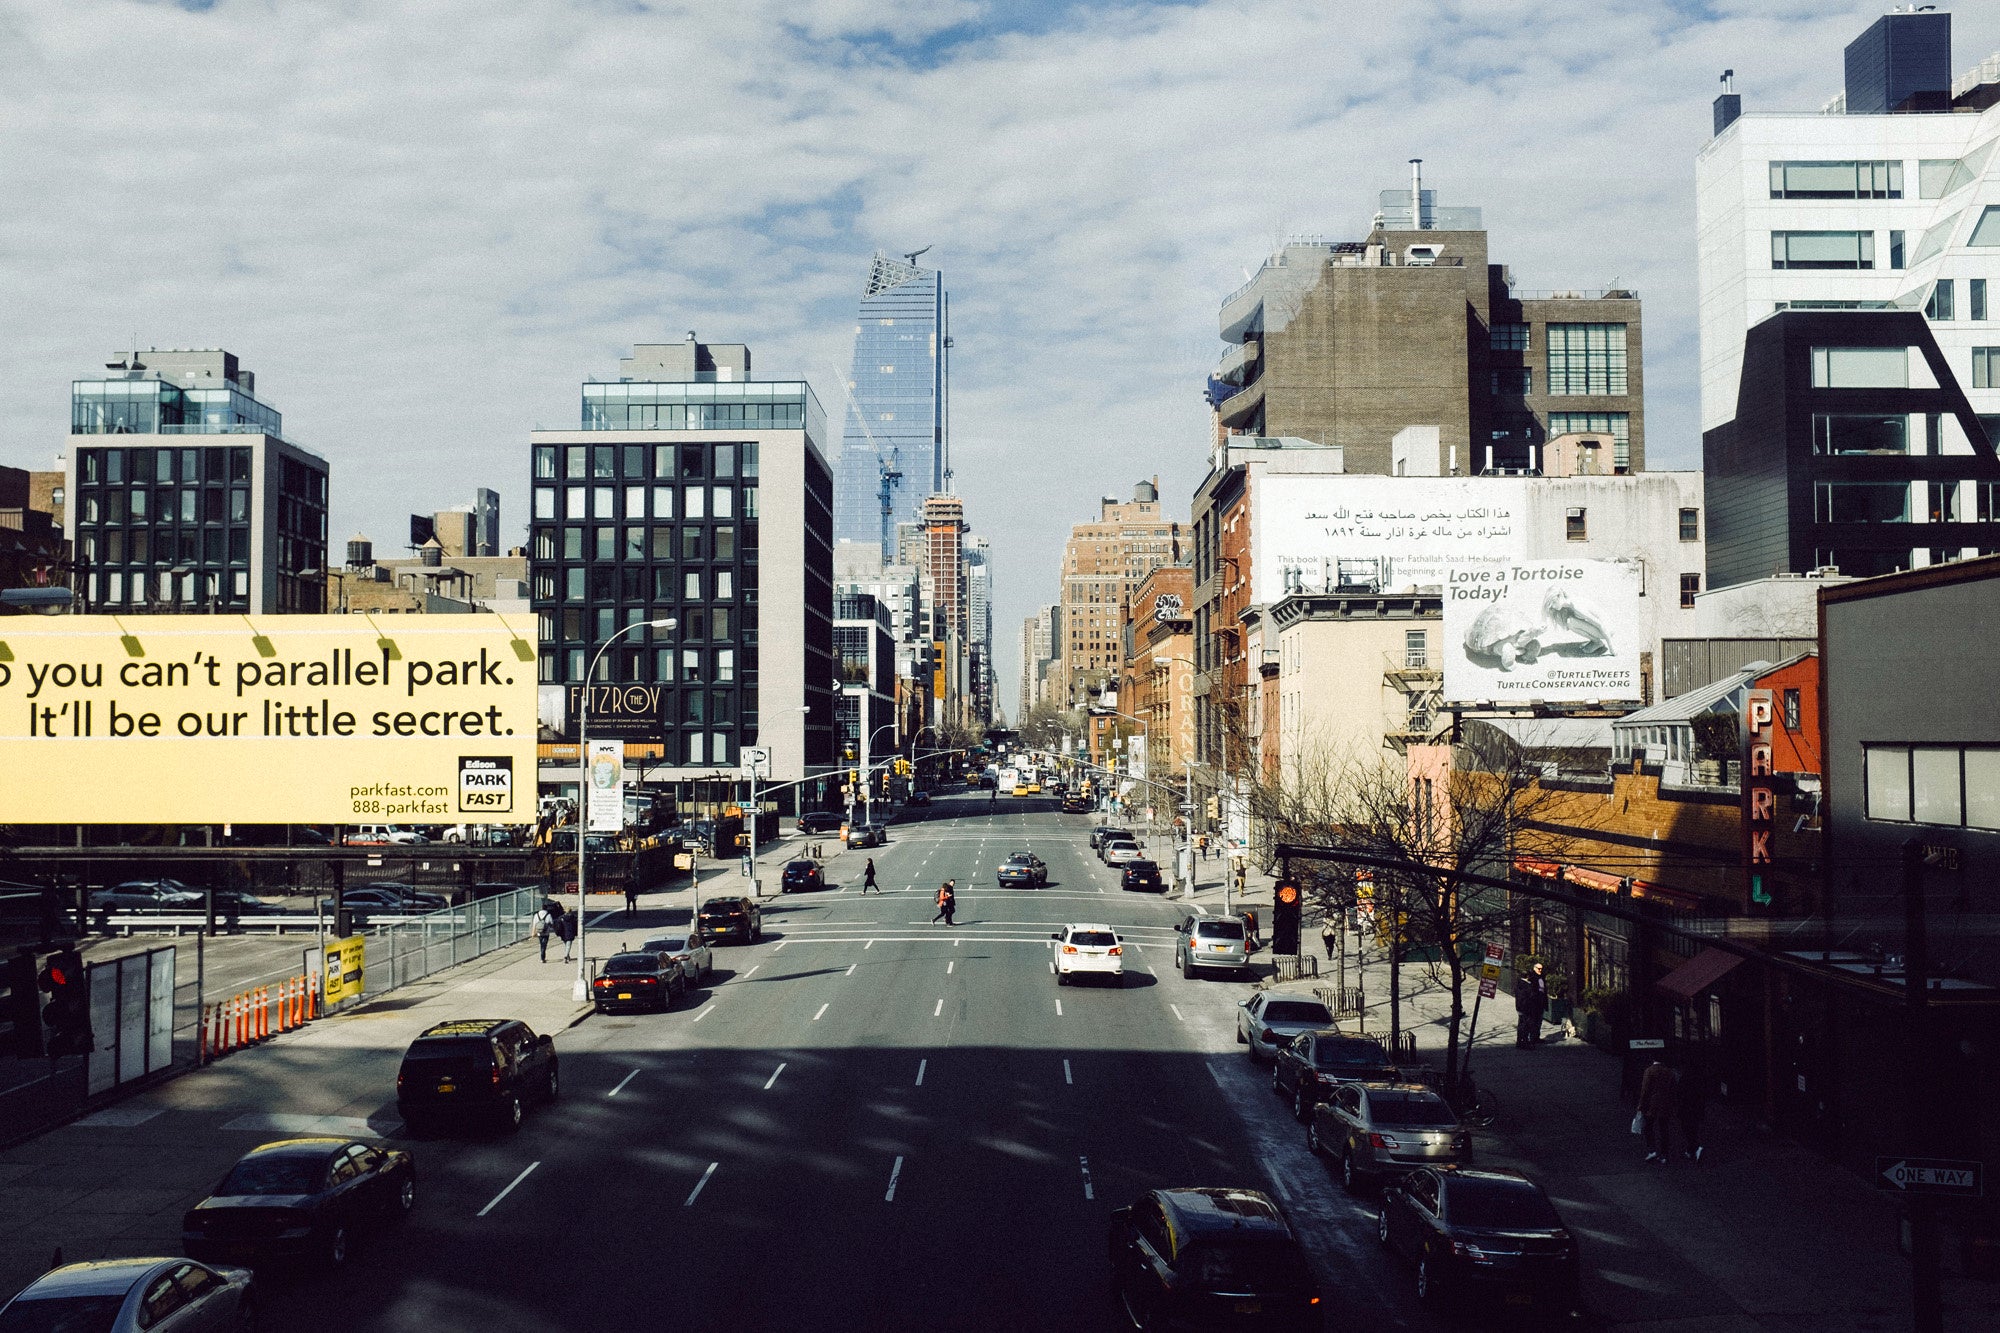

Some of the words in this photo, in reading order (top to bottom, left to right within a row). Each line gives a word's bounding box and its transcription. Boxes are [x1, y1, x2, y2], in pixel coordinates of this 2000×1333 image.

[1304, 511, 1329, 520] سعد
[1354, 509, 1374, 524] فتح
[1378, 509, 1416, 522] صاحبه
[1420, 508, 1452, 522] يخص
[1456, 507, 1489, 522] الكتاب
[1493, 507, 1511, 519] هذا
[1359, 526, 1381, 537] سنة
[1408, 527, 1428, 540] غرة
[1431, 526, 1452, 536] ماله
[1456, 528, 1473, 539] من
[1477, 525, 1511, 539] اشتراه
[1297, 555, 1318, 563] book
[1407, 554, 1443, 563] Fathallah
[1468, 555, 1481, 563] He
[1397, 567, 1436, 577] beginning
[1449, 568, 1491, 583] Love
[1496, 572, 1506, 582] a
[1511, 565, 1584, 581] Tortoise
[1449, 585, 1509, 603] Today!
[26, 662, 103, 699] you
[236, 648, 390, 697] parallel
[407, 647, 514, 697] park.
[629, 694, 643, 705] THE
[109, 700, 162, 737] be
[176, 711, 248, 737] our
[263, 698, 357, 737] little
[371, 703, 514, 737] secret.
[465, 759, 497, 769] Edison
[465, 774, 507, 786] PARK
[350, 782, 449, 799] parkfast.com
[466, 793, 506, 805] FAST
[352, 799, 449, 817] 888-parkfast
[1895, 1168, 1926, 1182] ONE
[1934, 1170, 1967, 1184] WAY
